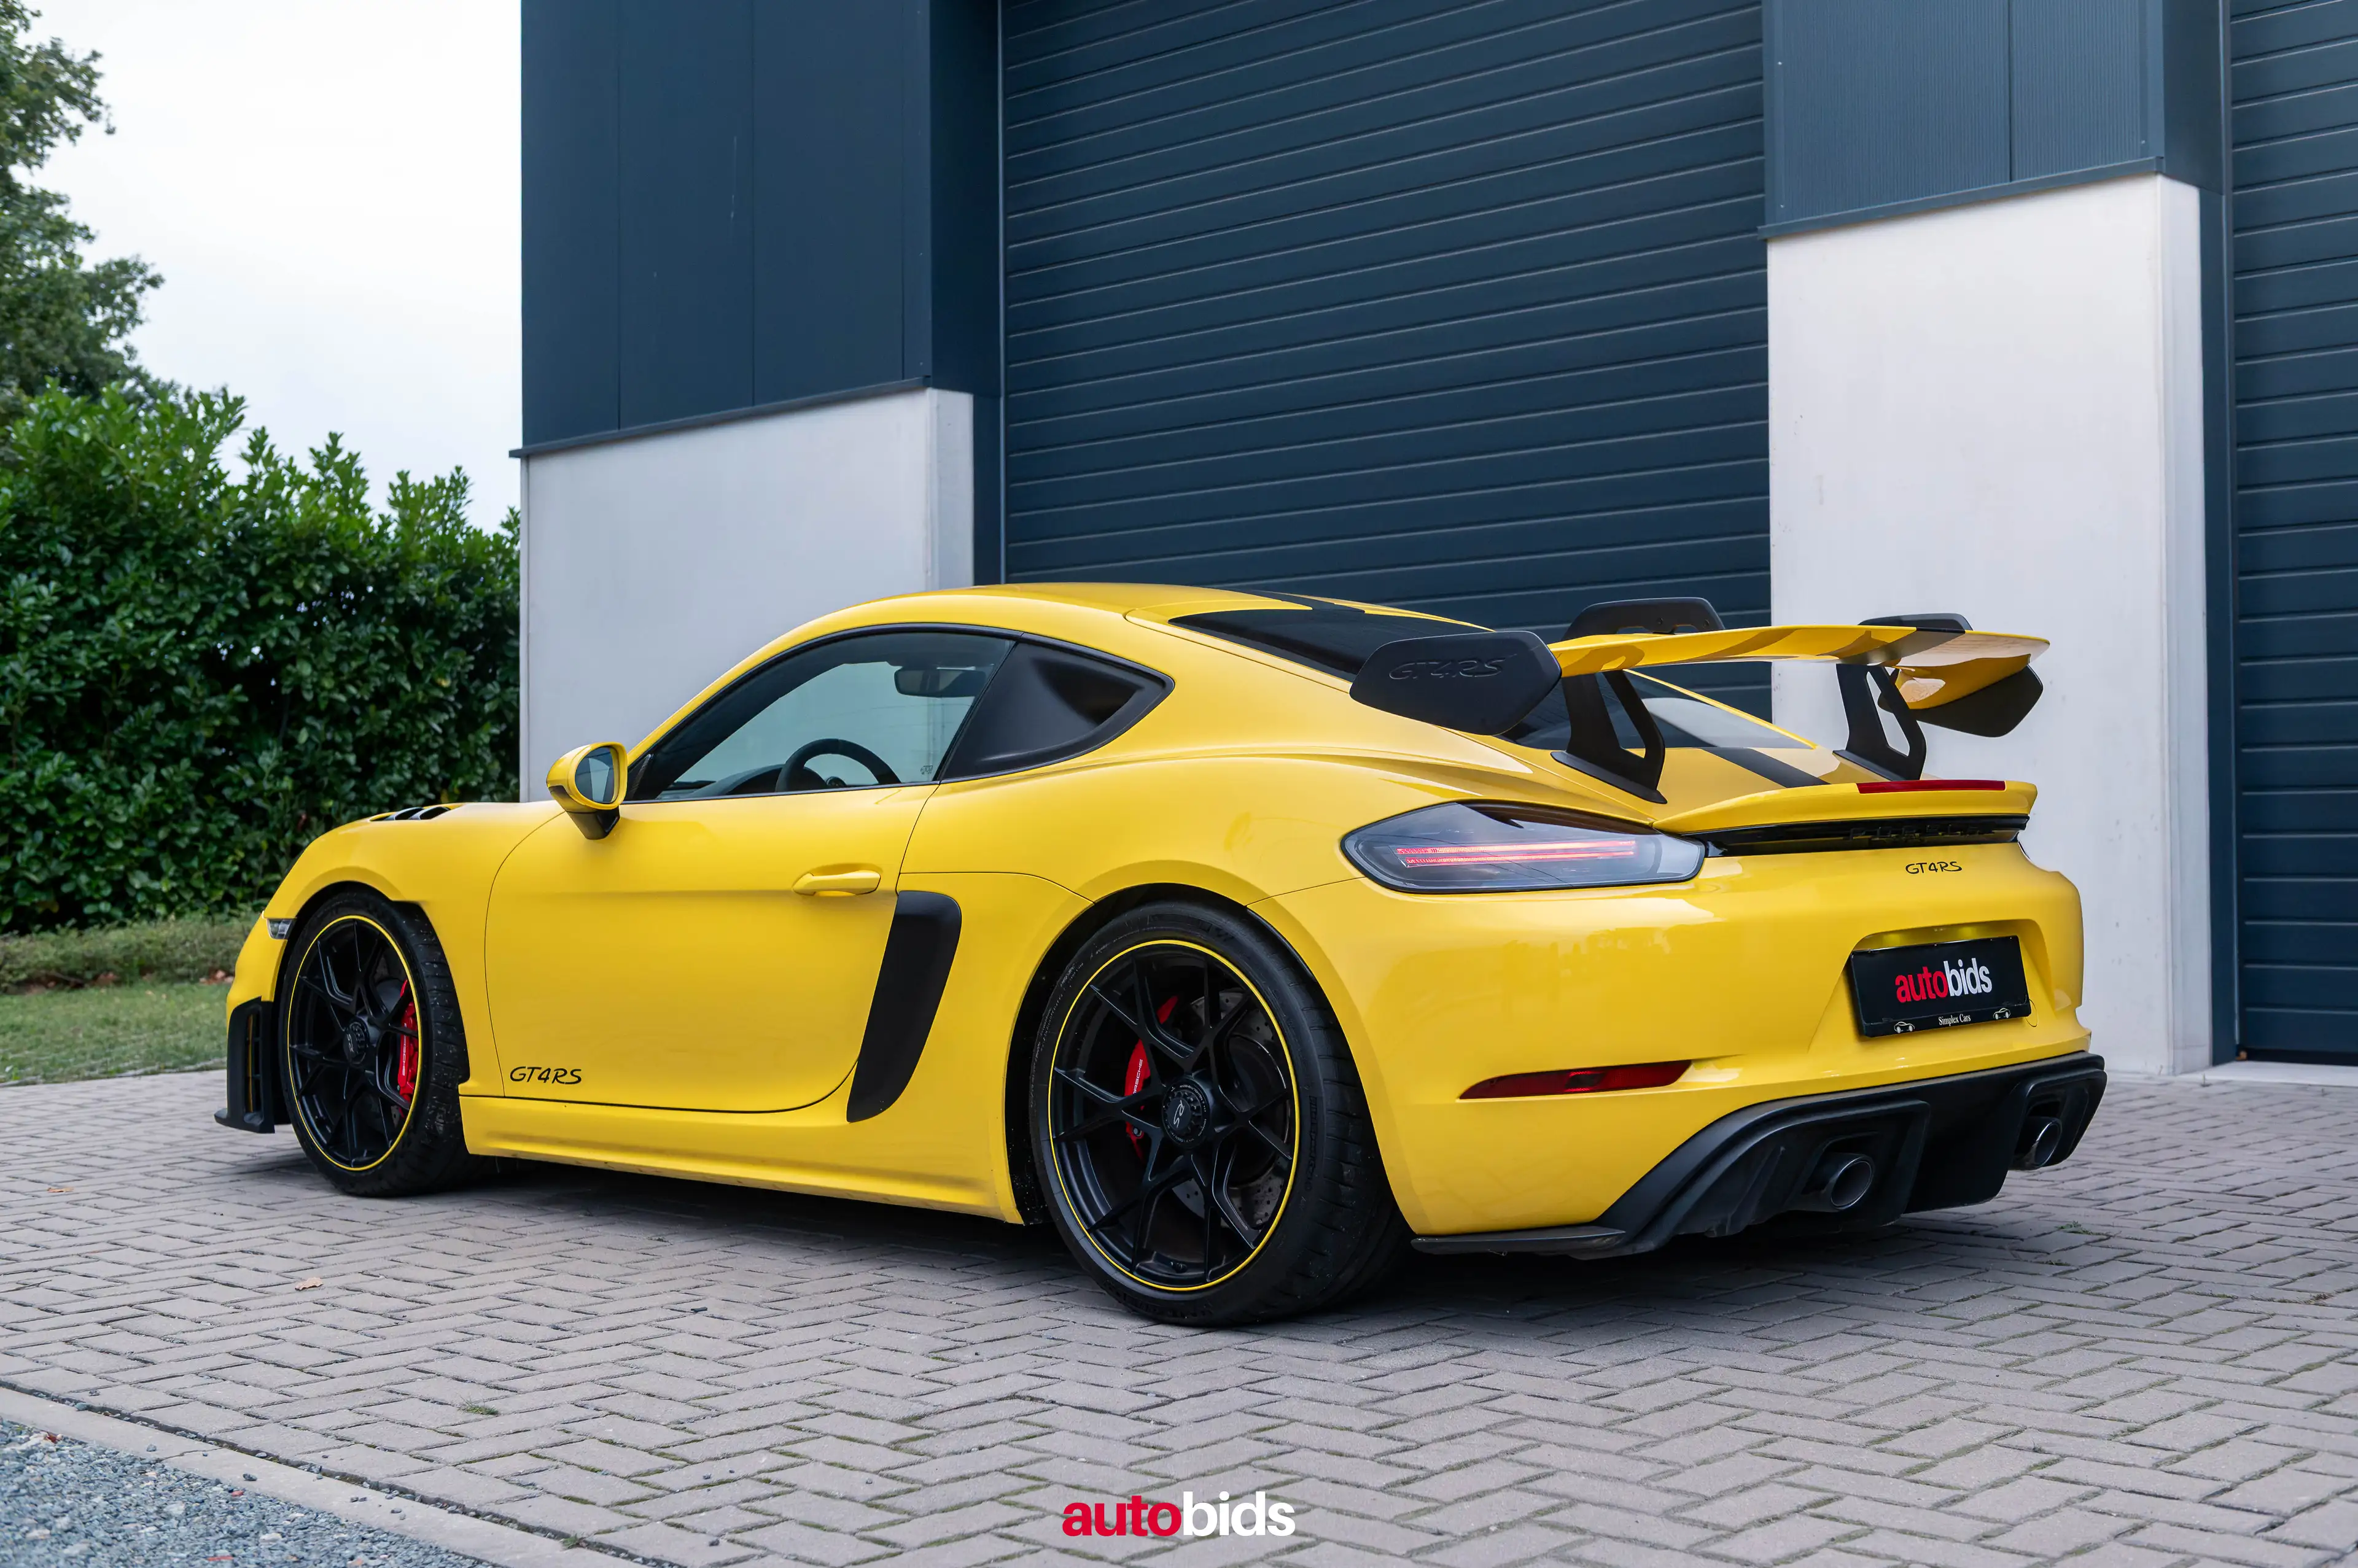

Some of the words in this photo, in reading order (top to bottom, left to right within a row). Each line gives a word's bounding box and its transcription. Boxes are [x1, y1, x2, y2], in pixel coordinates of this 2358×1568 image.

[1905, 861, 1963, 874] GT4RS
[1895, 958, 1993, 1003] autobids
[1939, 1015, 1959, 1026] Simplex
[1959, 1014, 1971, 1023] Cars
[510, 1066, 582, 1085] GT4RS
